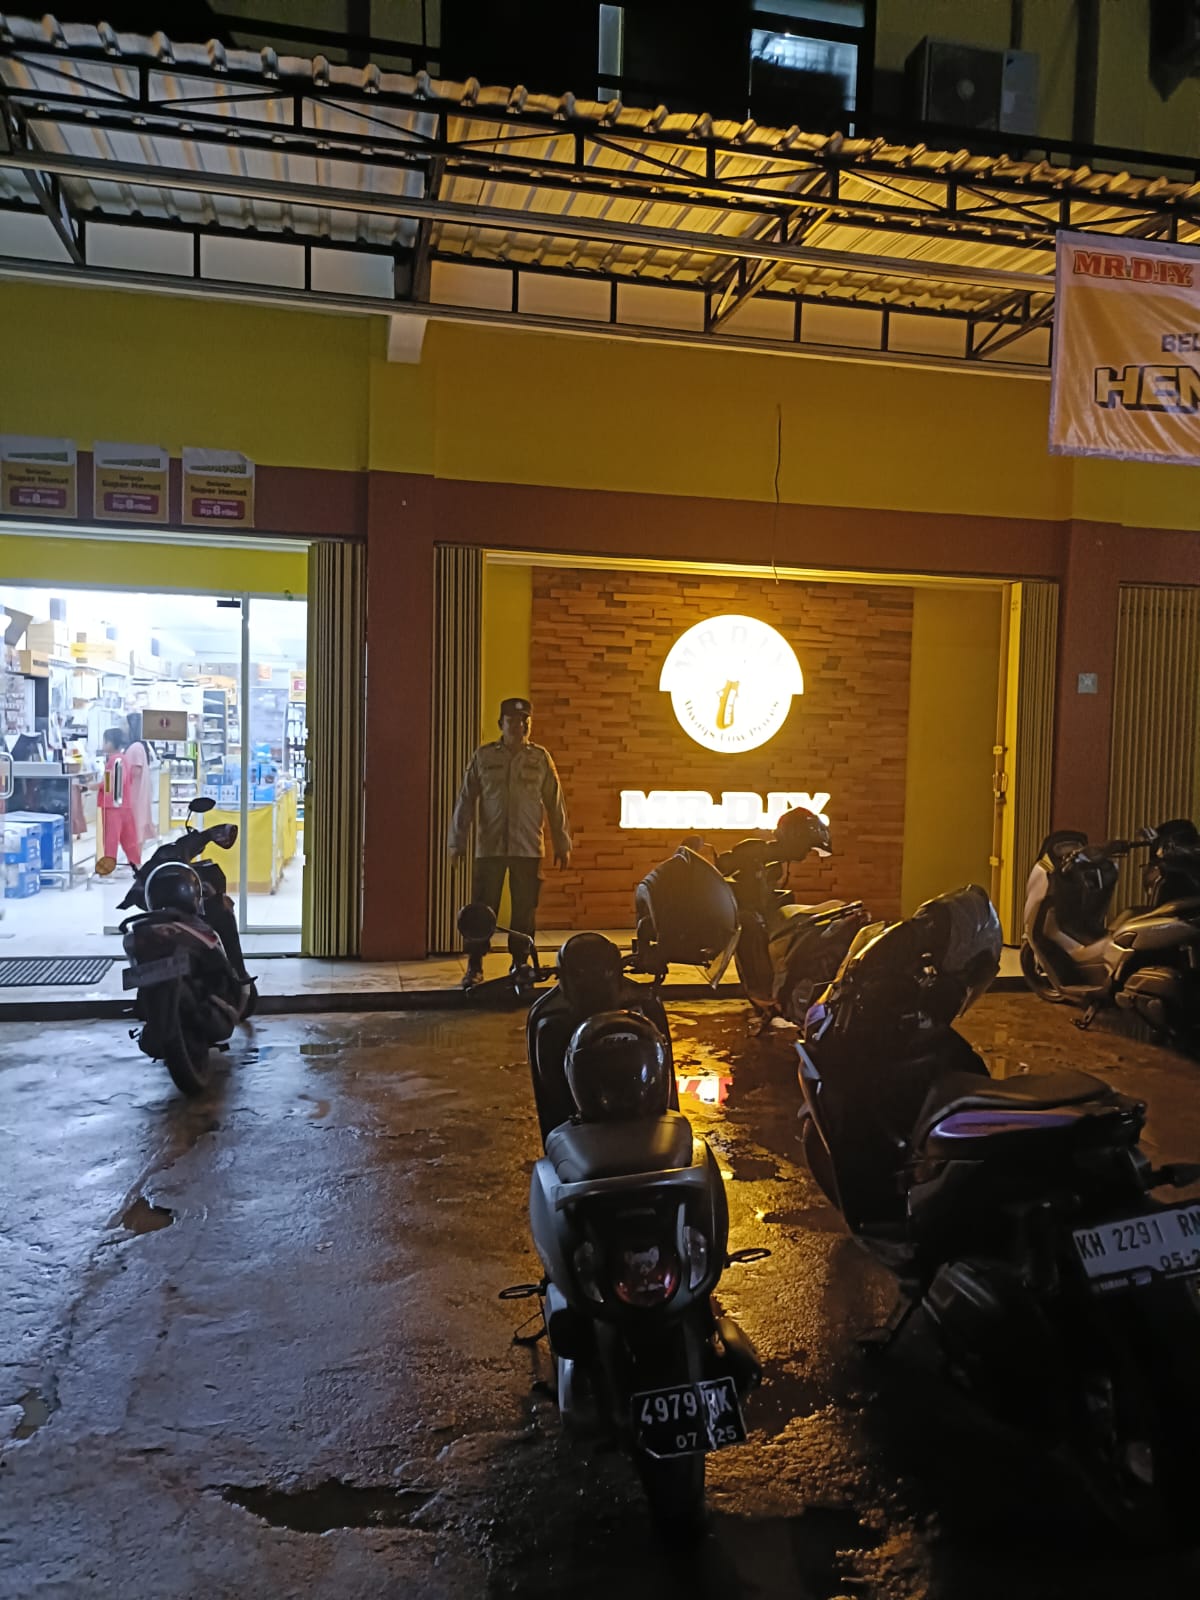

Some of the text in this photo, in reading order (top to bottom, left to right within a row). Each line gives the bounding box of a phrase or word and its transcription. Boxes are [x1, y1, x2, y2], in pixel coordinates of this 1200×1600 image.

[1112, 1220, 1164, 1251] 2291
[640, 1391, 698, 1424] 4979
[675, 1432, 698, 1449] 07
